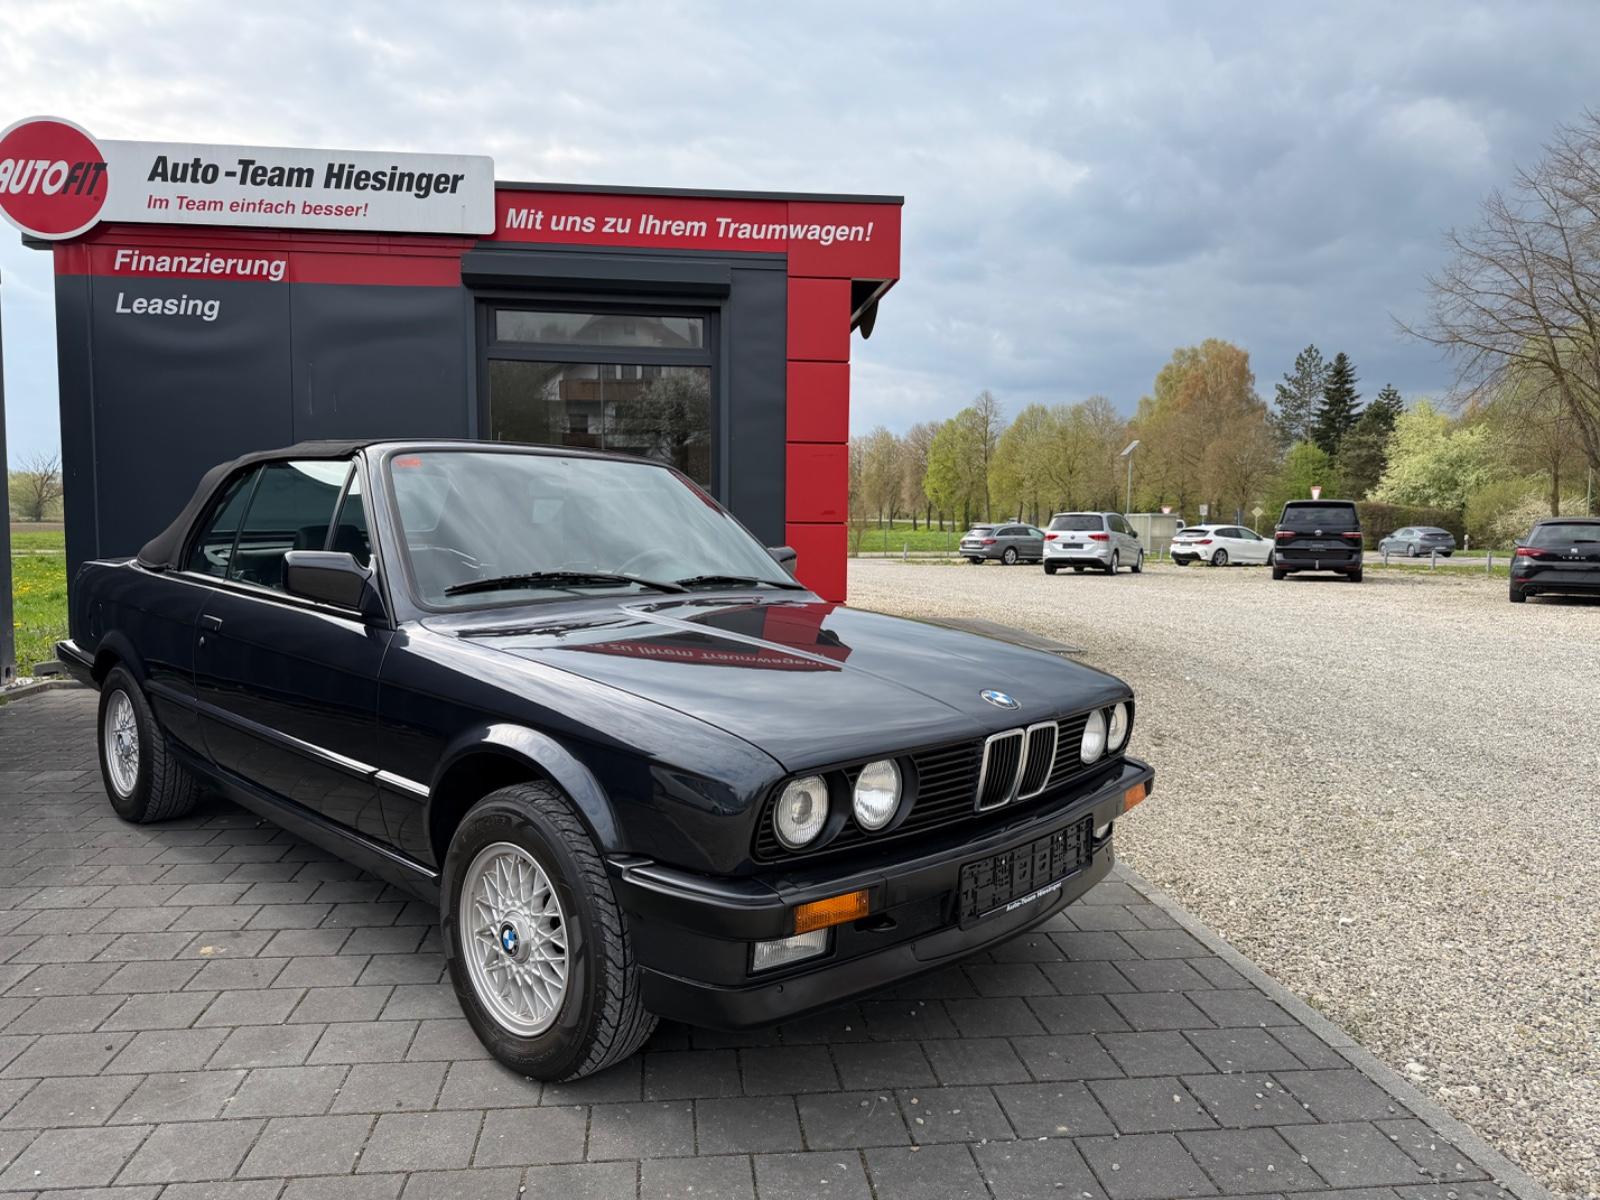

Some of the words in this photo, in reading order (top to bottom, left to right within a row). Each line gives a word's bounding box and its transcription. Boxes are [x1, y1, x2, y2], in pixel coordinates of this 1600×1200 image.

[323, 162, 465, 199] Hiesinger
[147, 194, 169, 210] Im
[176, 195, 223, 212] Team
[229, 197, 295, 215] einfach
[301, 201, 368, 217] besser!
[505, 207, 544, 230] Mit
[550, 212, 596, 233] uns
[602, 215, 631, 234] zu
[638, 213, 707, 238] Ihrem
[716, 217, 874, 246] Traumwagen!
[113, 249, 287, 281] Finanzierung
[115, 292, 220, 322] Leasing
